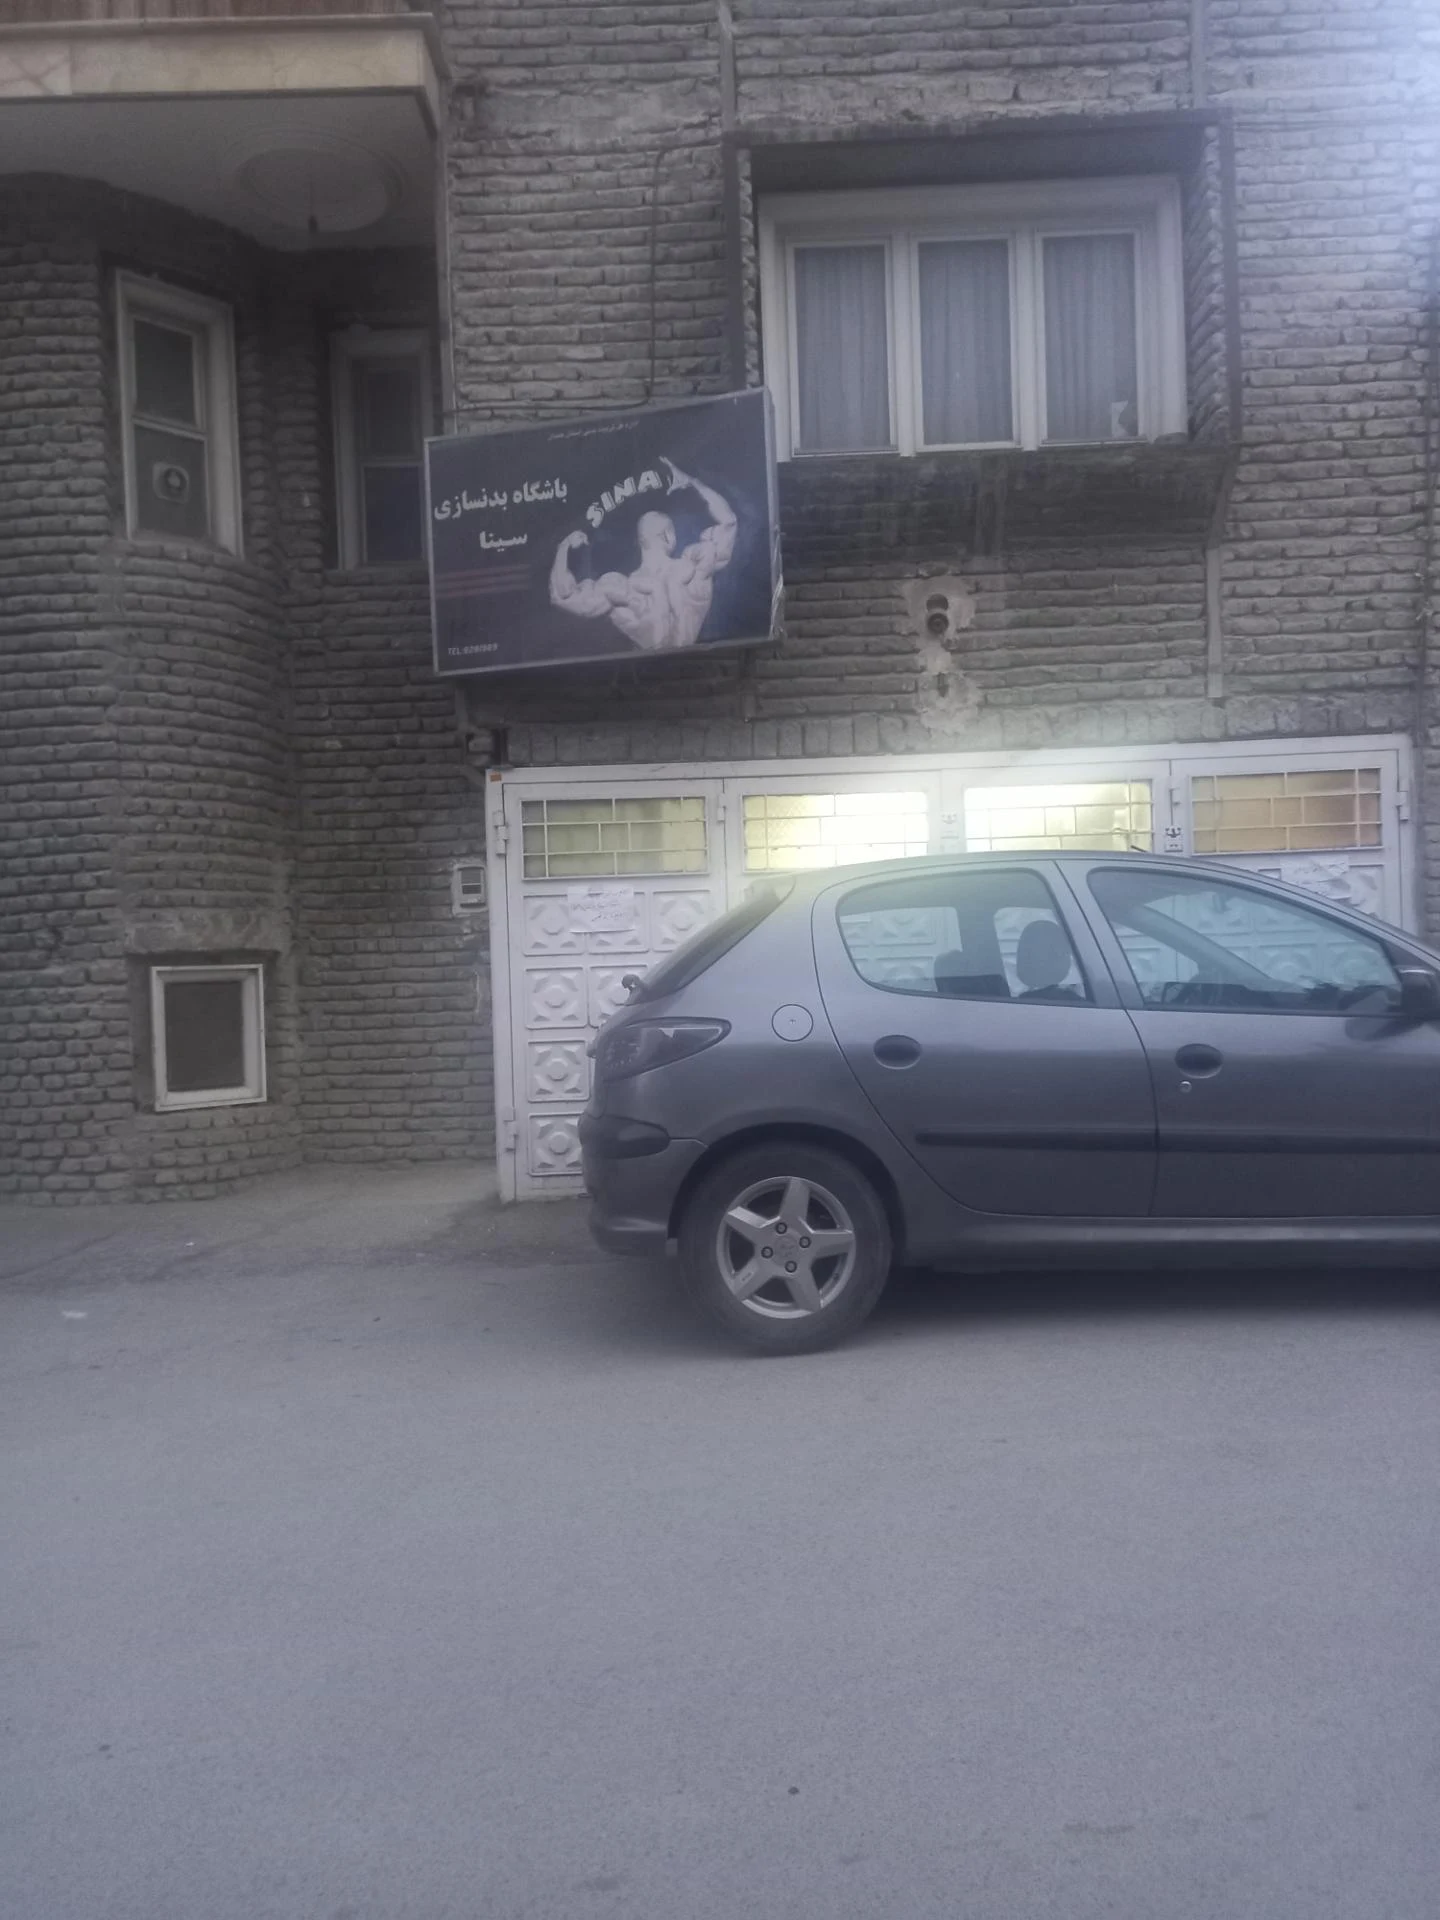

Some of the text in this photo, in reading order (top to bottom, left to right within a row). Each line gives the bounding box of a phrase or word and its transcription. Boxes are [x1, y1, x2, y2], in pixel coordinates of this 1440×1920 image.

[434, 478, 567, 520] باشگاه بدنسازی
[586, 470, 662, 528] SINA
[479, 531, 528, 552] سینا
